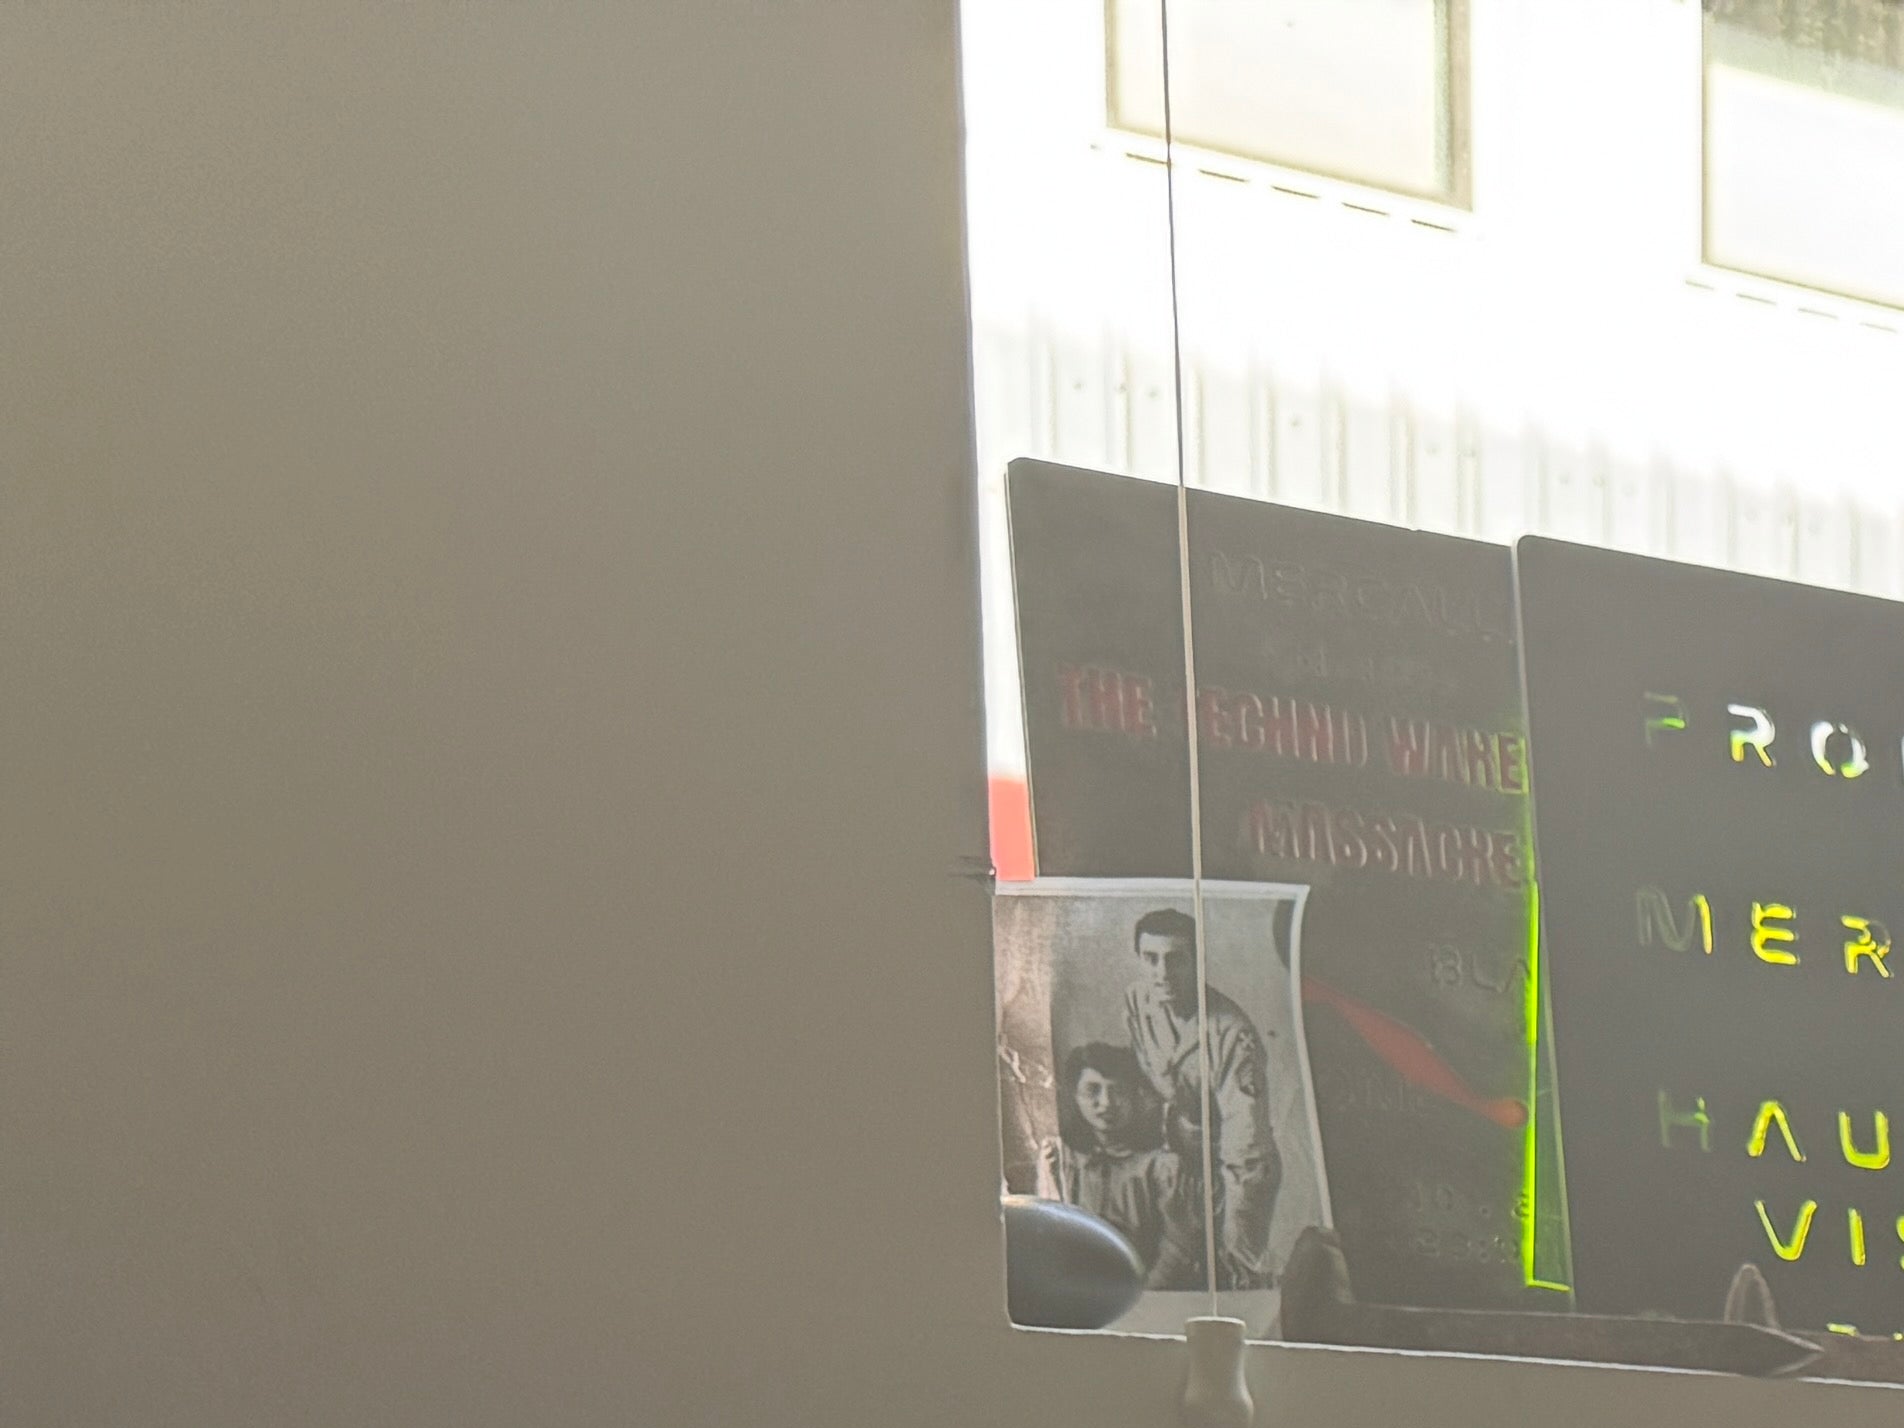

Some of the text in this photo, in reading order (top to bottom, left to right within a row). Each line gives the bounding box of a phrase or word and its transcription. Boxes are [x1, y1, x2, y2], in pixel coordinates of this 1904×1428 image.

[1057, 662, 1156, 738] THE
[1177, 685, 1370, 768] ECHNO
[1246, 798, 1524, 889] MASSACRE
